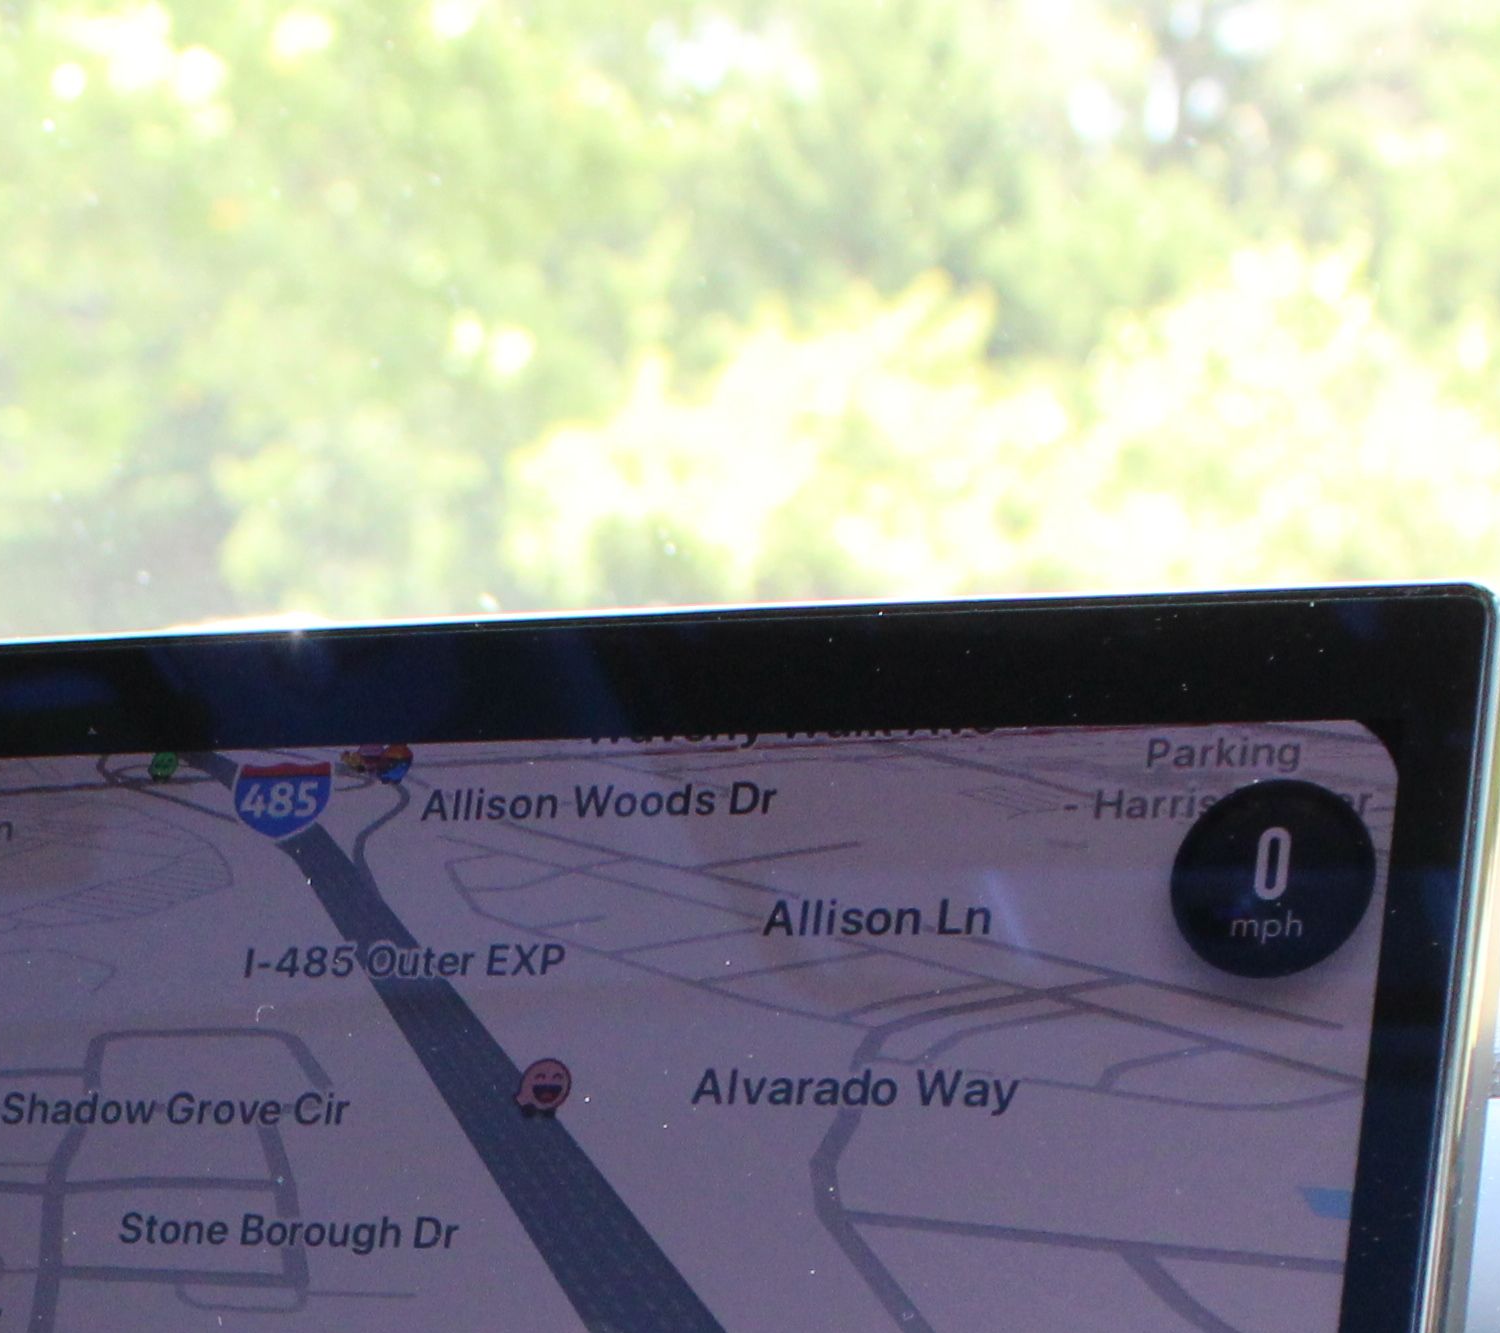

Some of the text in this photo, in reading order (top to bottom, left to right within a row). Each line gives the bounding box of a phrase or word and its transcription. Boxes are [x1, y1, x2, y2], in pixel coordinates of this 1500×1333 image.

[1147, 738, 1301, 773] Parking
[240, 781, 320, 819] 485
[421, 780, 778, 822] Allison Woods Dr
[1254, 826, 1293, 901] 0
[762, 899, 993, 938] Allison Ln
[1231, 911, 1303, 945] mph
[244, 943, 567, 979] I-485 Outer EXP
[1, 1091, 351, 1127] Shadow Grove Cir
[690, 1068, 1021, 1117] Alvarado Way
[118, 1212, 461, 1256] Stone Borough Dr
